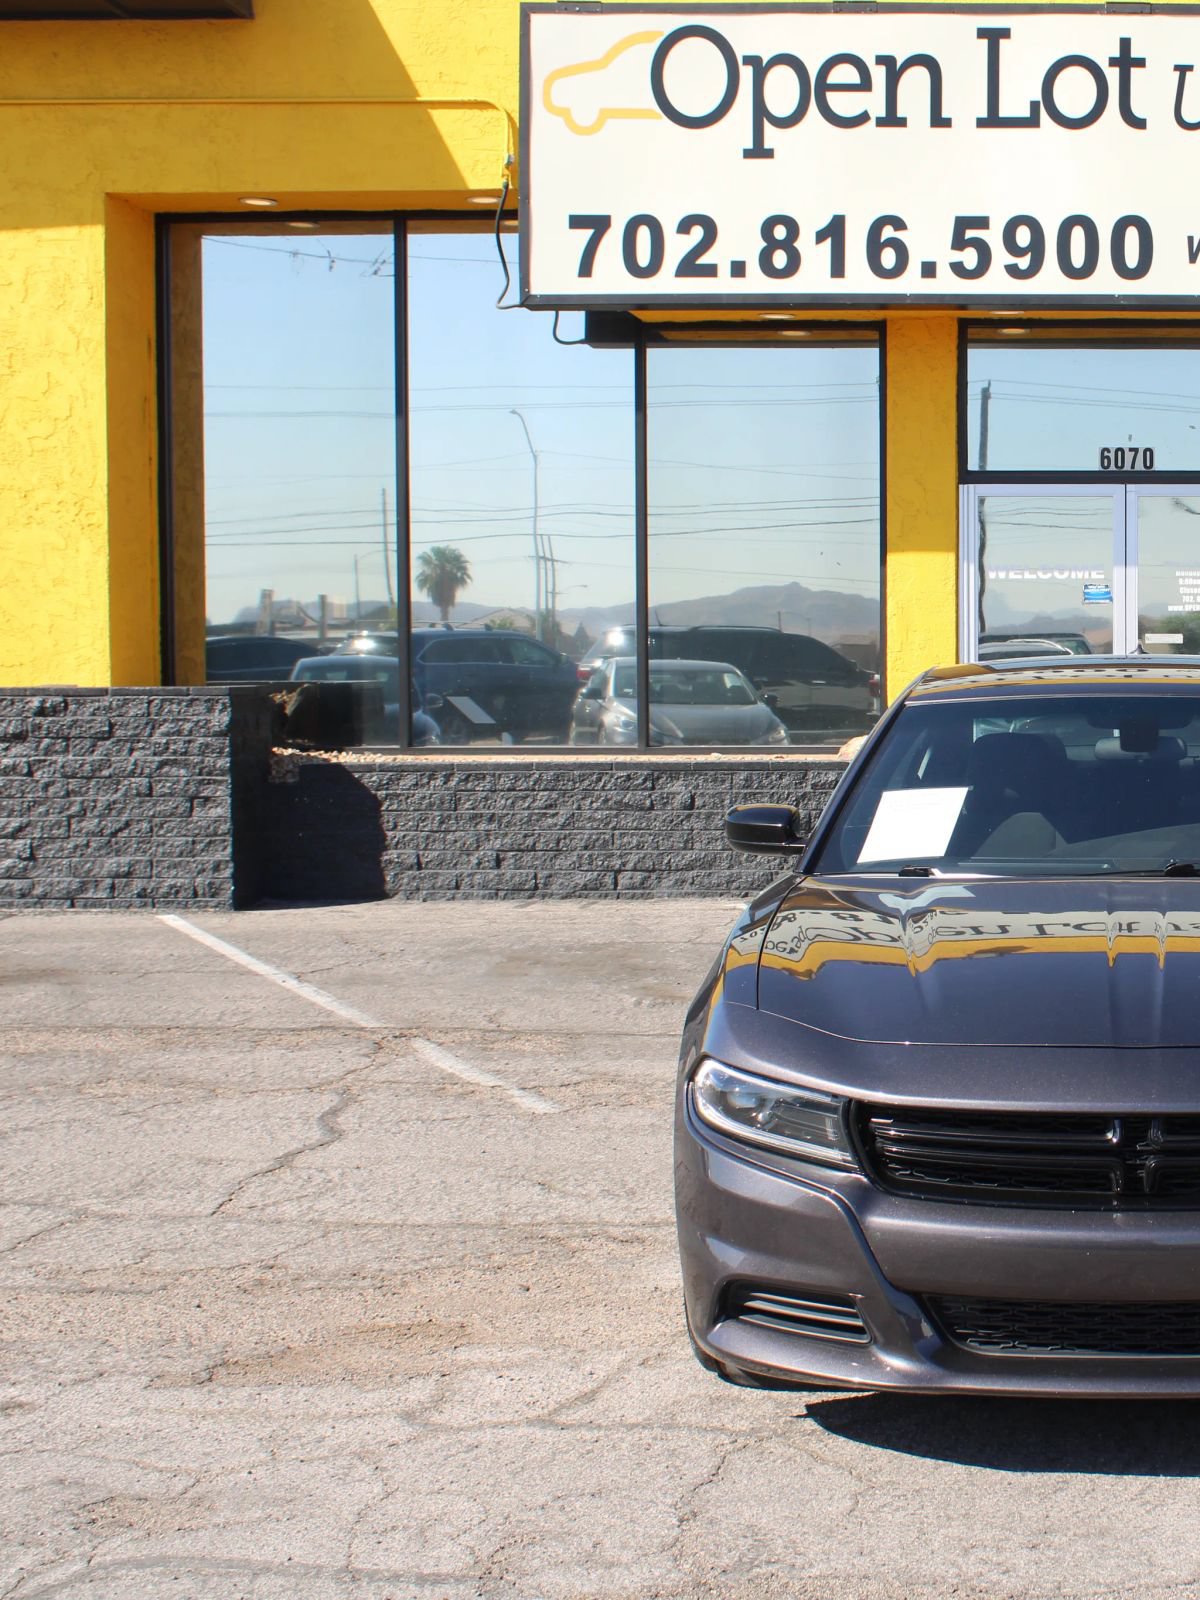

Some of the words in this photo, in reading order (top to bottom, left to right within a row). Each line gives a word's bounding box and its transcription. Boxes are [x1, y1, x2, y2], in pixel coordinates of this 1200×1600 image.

[650, 24, 953, 159] Open
[976, 27, 1147, 130] Lot
[568, 213, 1154, 281] 702.816.5900
[1100, 447, 1155, 471] 6070
[987, 564, 1105, 580] WELCOME
